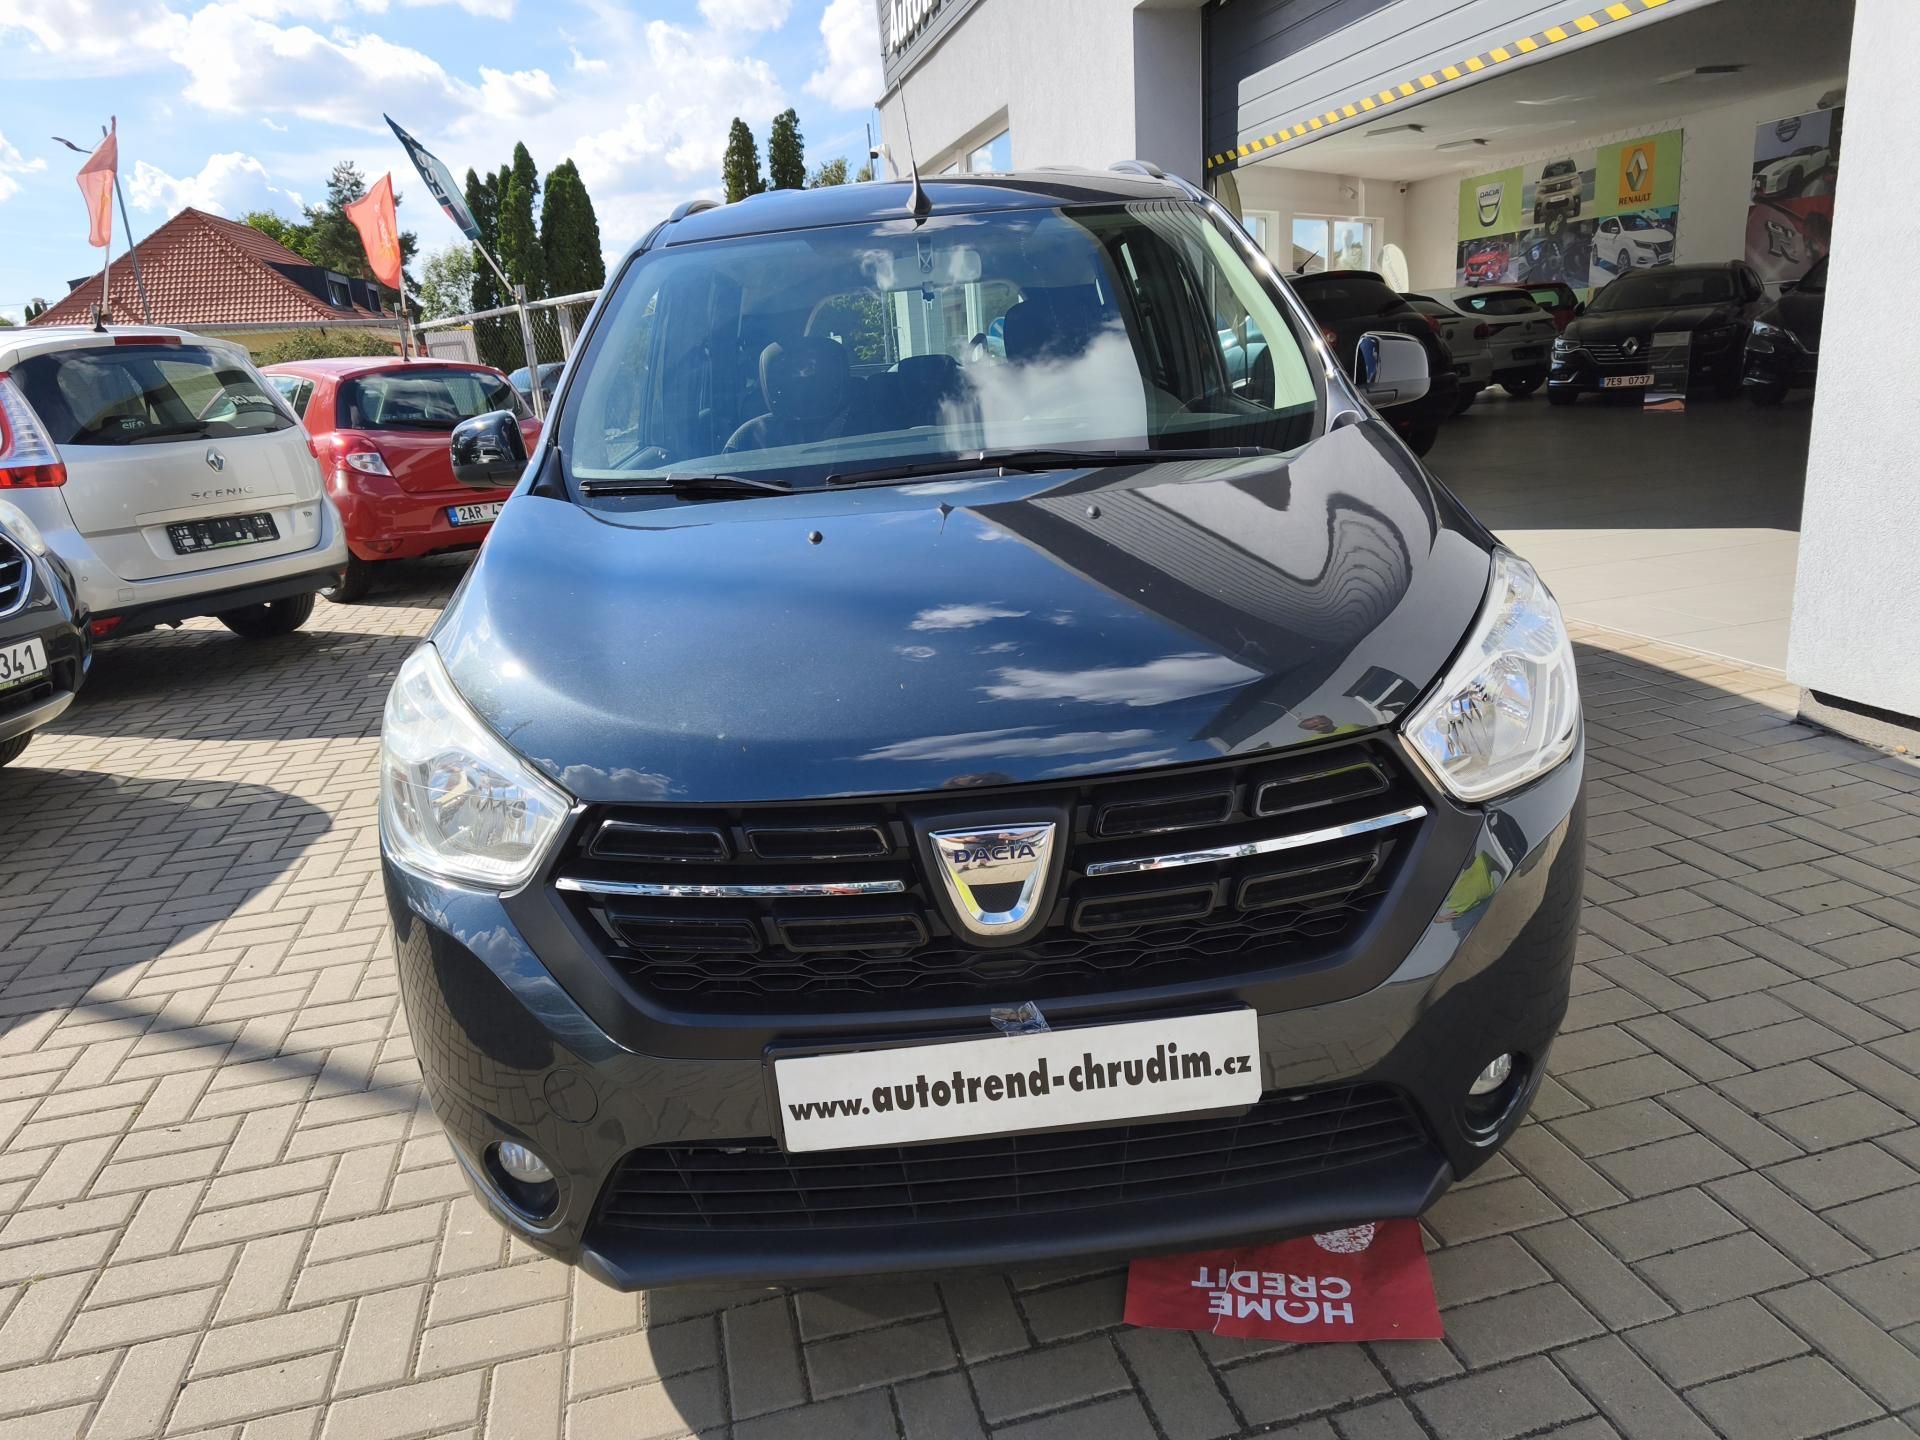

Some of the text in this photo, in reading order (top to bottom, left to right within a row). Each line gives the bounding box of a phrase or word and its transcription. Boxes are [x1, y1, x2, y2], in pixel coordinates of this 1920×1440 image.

[1479, 188, 1500, 199] DACIA
[1618, 193, 1652, 206] RENAULT
[1606, 375, 1651, 387] 7E9 0737
[190, 486, 256, 499] SCENIC
[459, 506, 483, 520] 2AR
[953, 843, 1036, 863] DACIA
[787, 1041, 1253, 1122] www.autotrend-chrudim.cz
[1191, 1266, 1352, 1299] CREDIT
[1208, 1291, 1354, 1324] HOME
